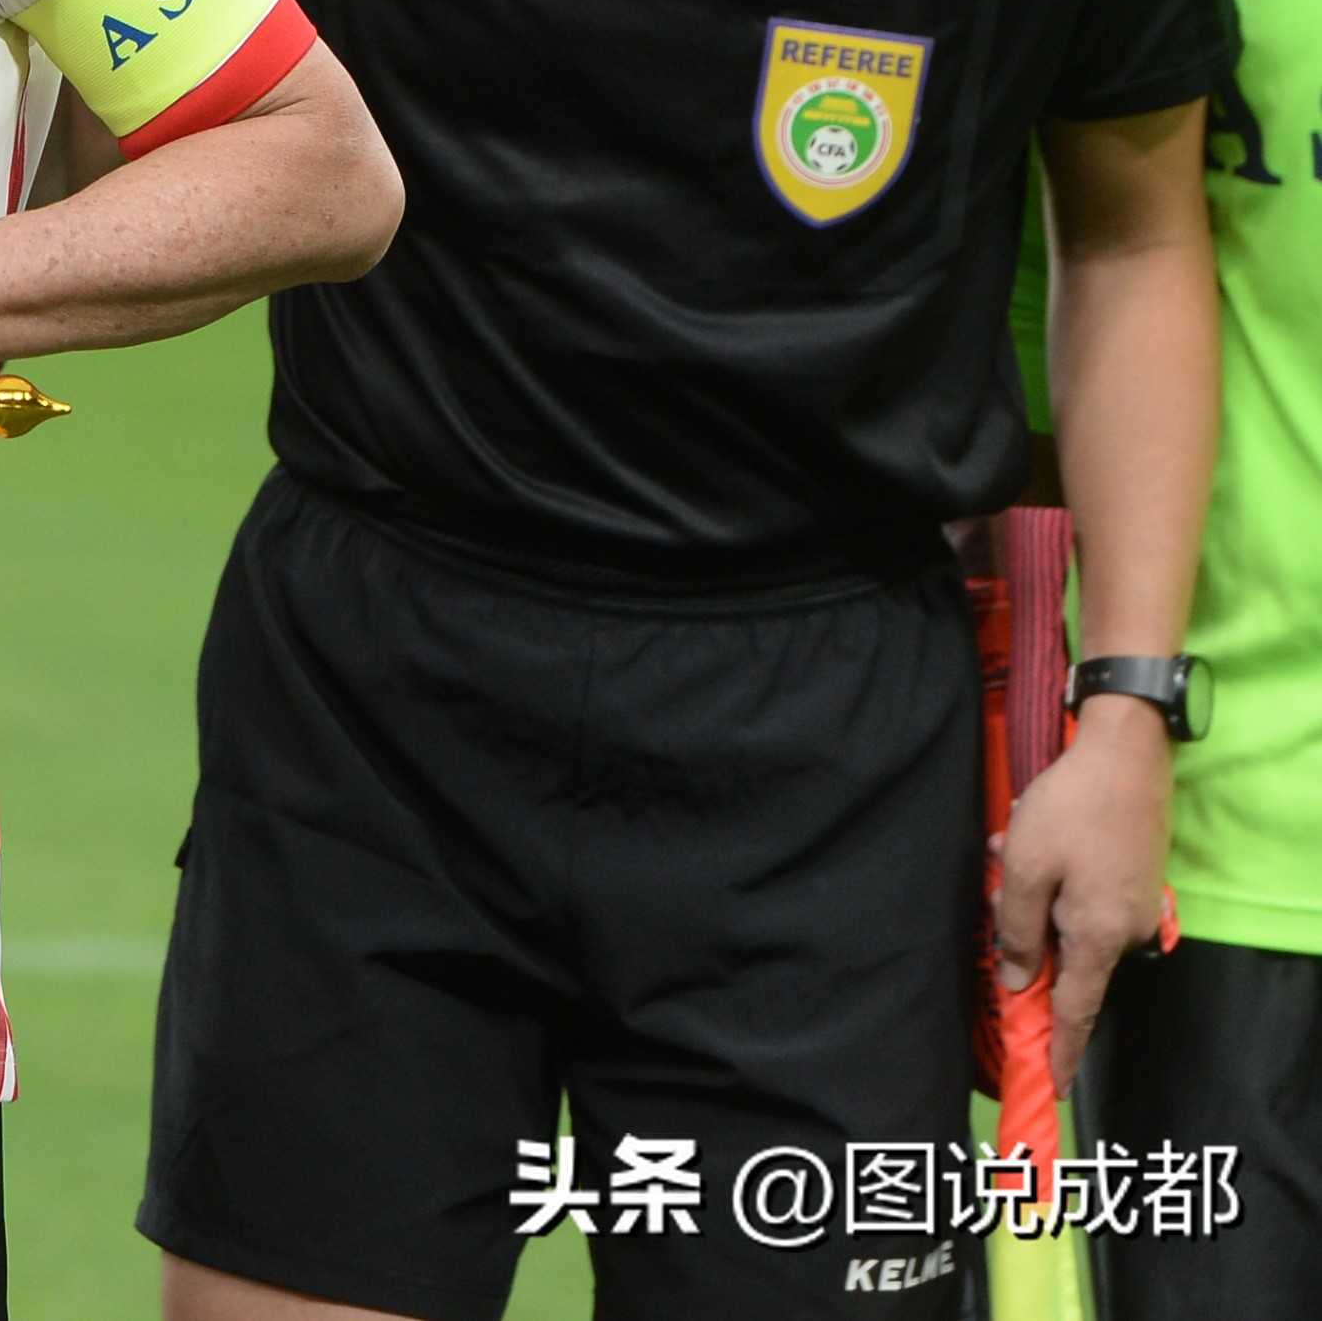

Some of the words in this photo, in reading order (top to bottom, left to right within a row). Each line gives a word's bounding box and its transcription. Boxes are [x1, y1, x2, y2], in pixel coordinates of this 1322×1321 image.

[780, 38, 915, 78] REFEREE
[816, 142, 847, 158] CFA
[844, 1239, 956, 1293] KELME
